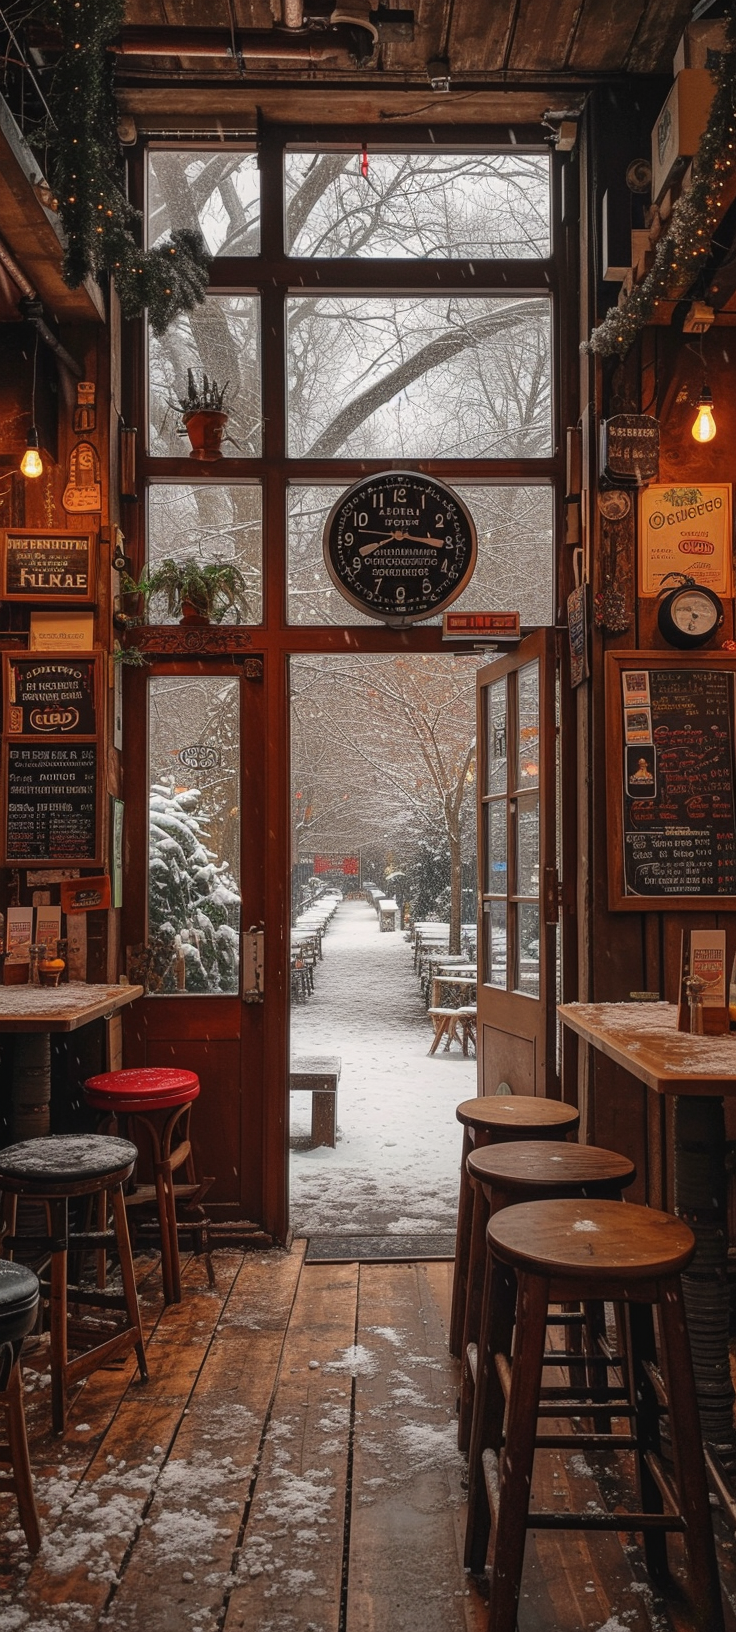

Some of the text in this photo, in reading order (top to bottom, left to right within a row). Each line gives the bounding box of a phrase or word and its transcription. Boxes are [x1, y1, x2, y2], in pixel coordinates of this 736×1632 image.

[372, 493, 384, 508] 11
[353, 511, 369, 527] 10
[435, 513, 445, 528] 2
[344, 532, 354, 547] 9
[440, 558, 449, 574] 4
[374, 578, 383, 595] 7
